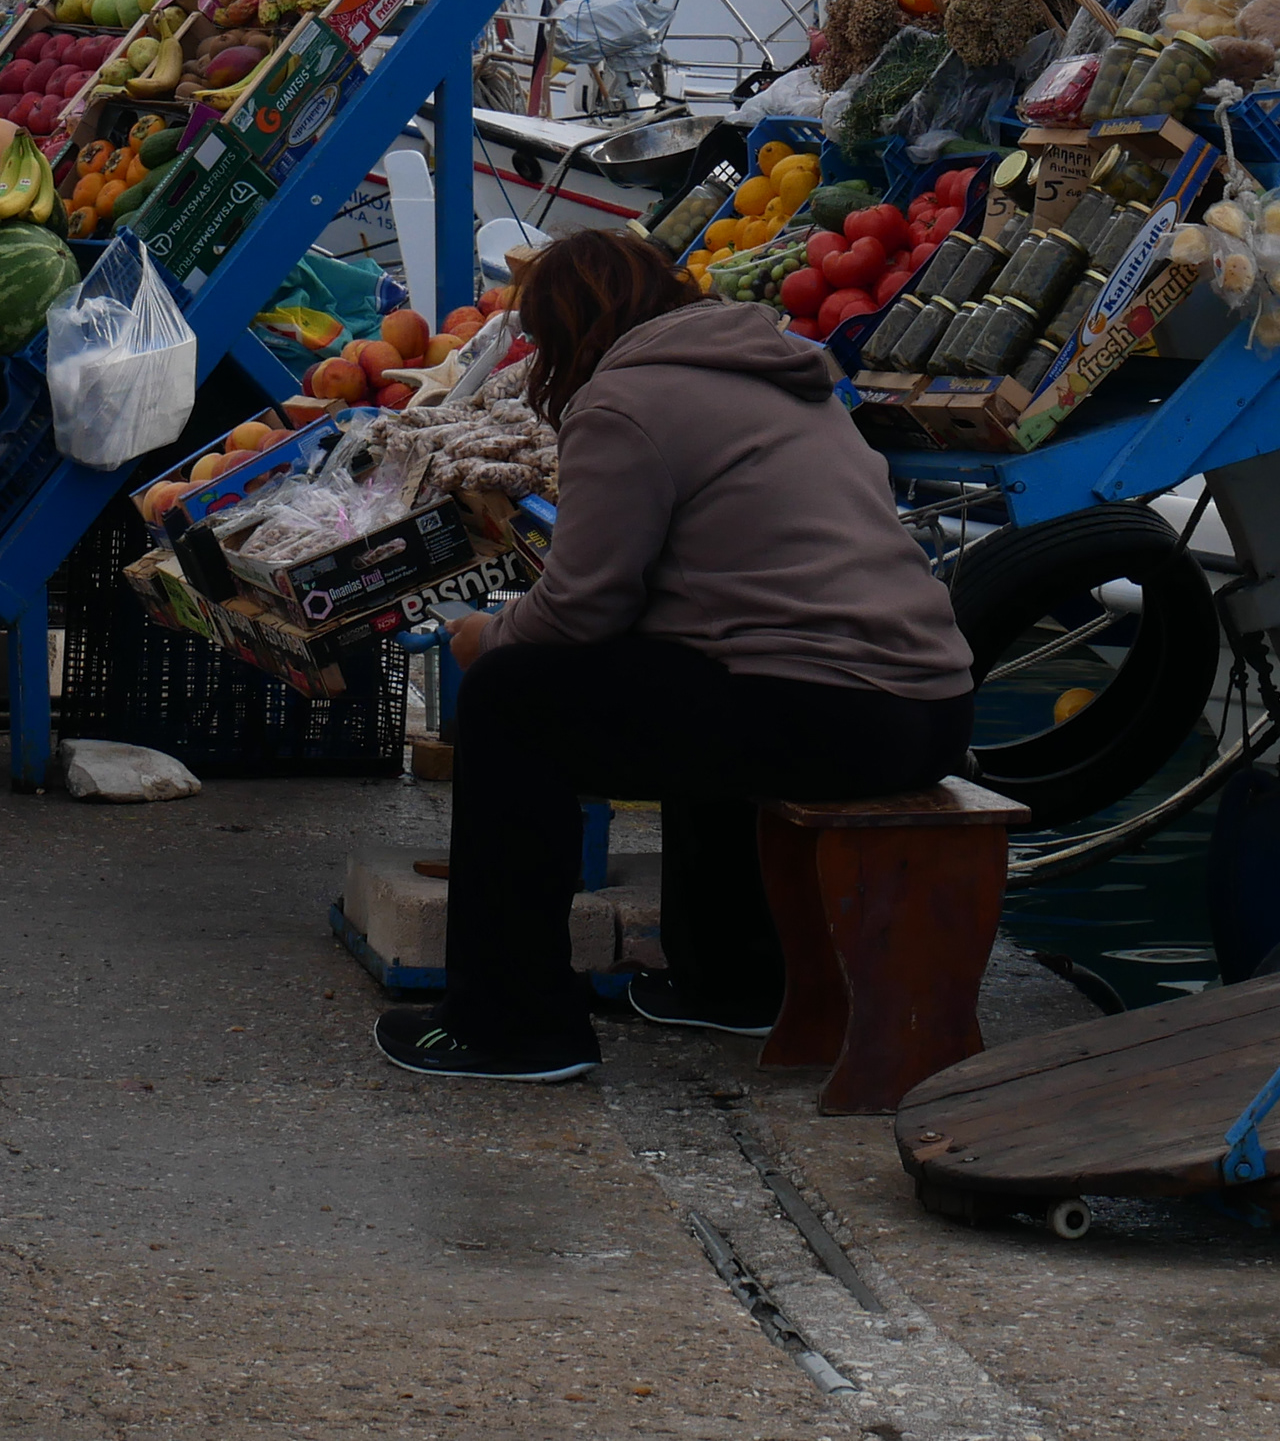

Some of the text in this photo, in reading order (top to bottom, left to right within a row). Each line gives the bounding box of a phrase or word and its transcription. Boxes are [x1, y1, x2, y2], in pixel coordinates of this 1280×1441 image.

[276, 69, 310, 112] GIANTSIS
[168, 151, 237, 236] TSIATSMAS FRUITS
[377, 216, 397, 232] 15
[173, 200, 236, 280] TSIATSMAS FRUIT
[1104, 216, 1169, 313] Kalaitzidis
[1077, 263, 1200, 385] fresh fruit
[328, 578, 363, 601] Ananias
[377, 616, 397, 630] ACN
[401, 551, 521, 624] ugusta
